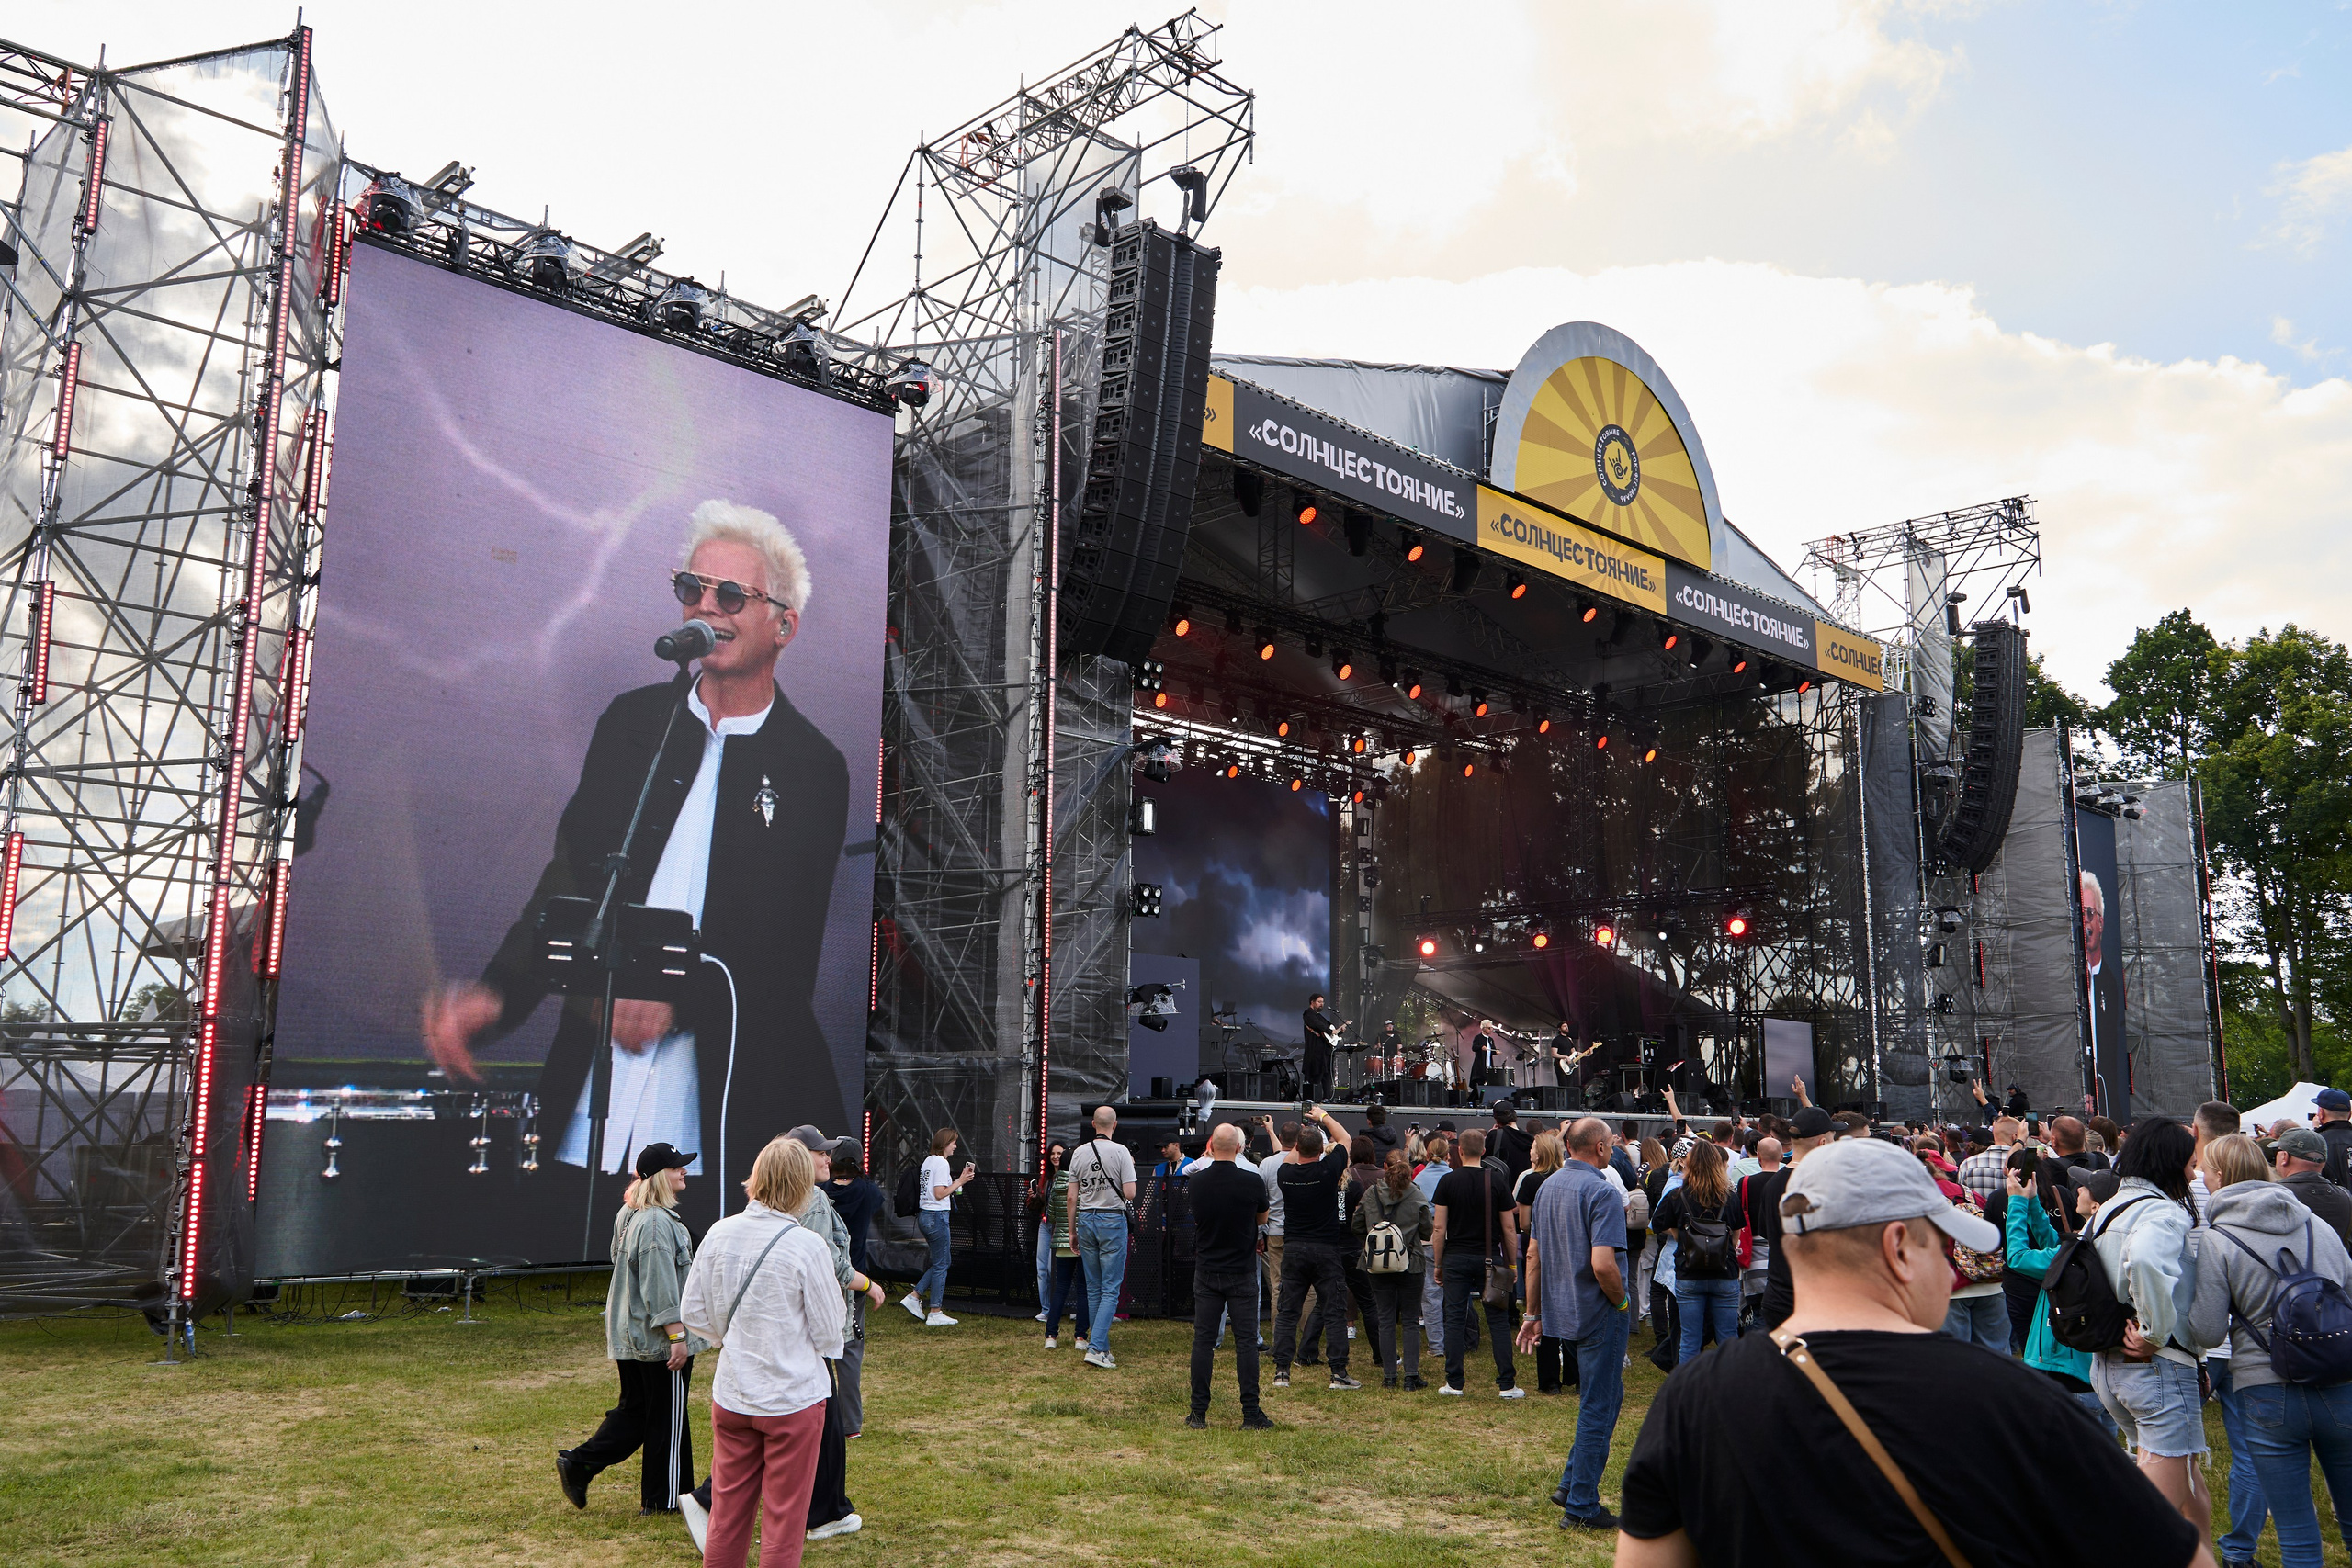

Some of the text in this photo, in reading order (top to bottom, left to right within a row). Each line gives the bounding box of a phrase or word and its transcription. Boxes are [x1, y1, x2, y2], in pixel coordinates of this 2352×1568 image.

[1249, 418, 1465, 520] «СОЛНЦЕСТОЯНИЕ»
[1489, 513, 1657, 593] «СОЛНЦЕСТОЯНИЕ»
[1675, 585, 1810, 650] «СОЛНЦЕСТОЯНИЕ»
